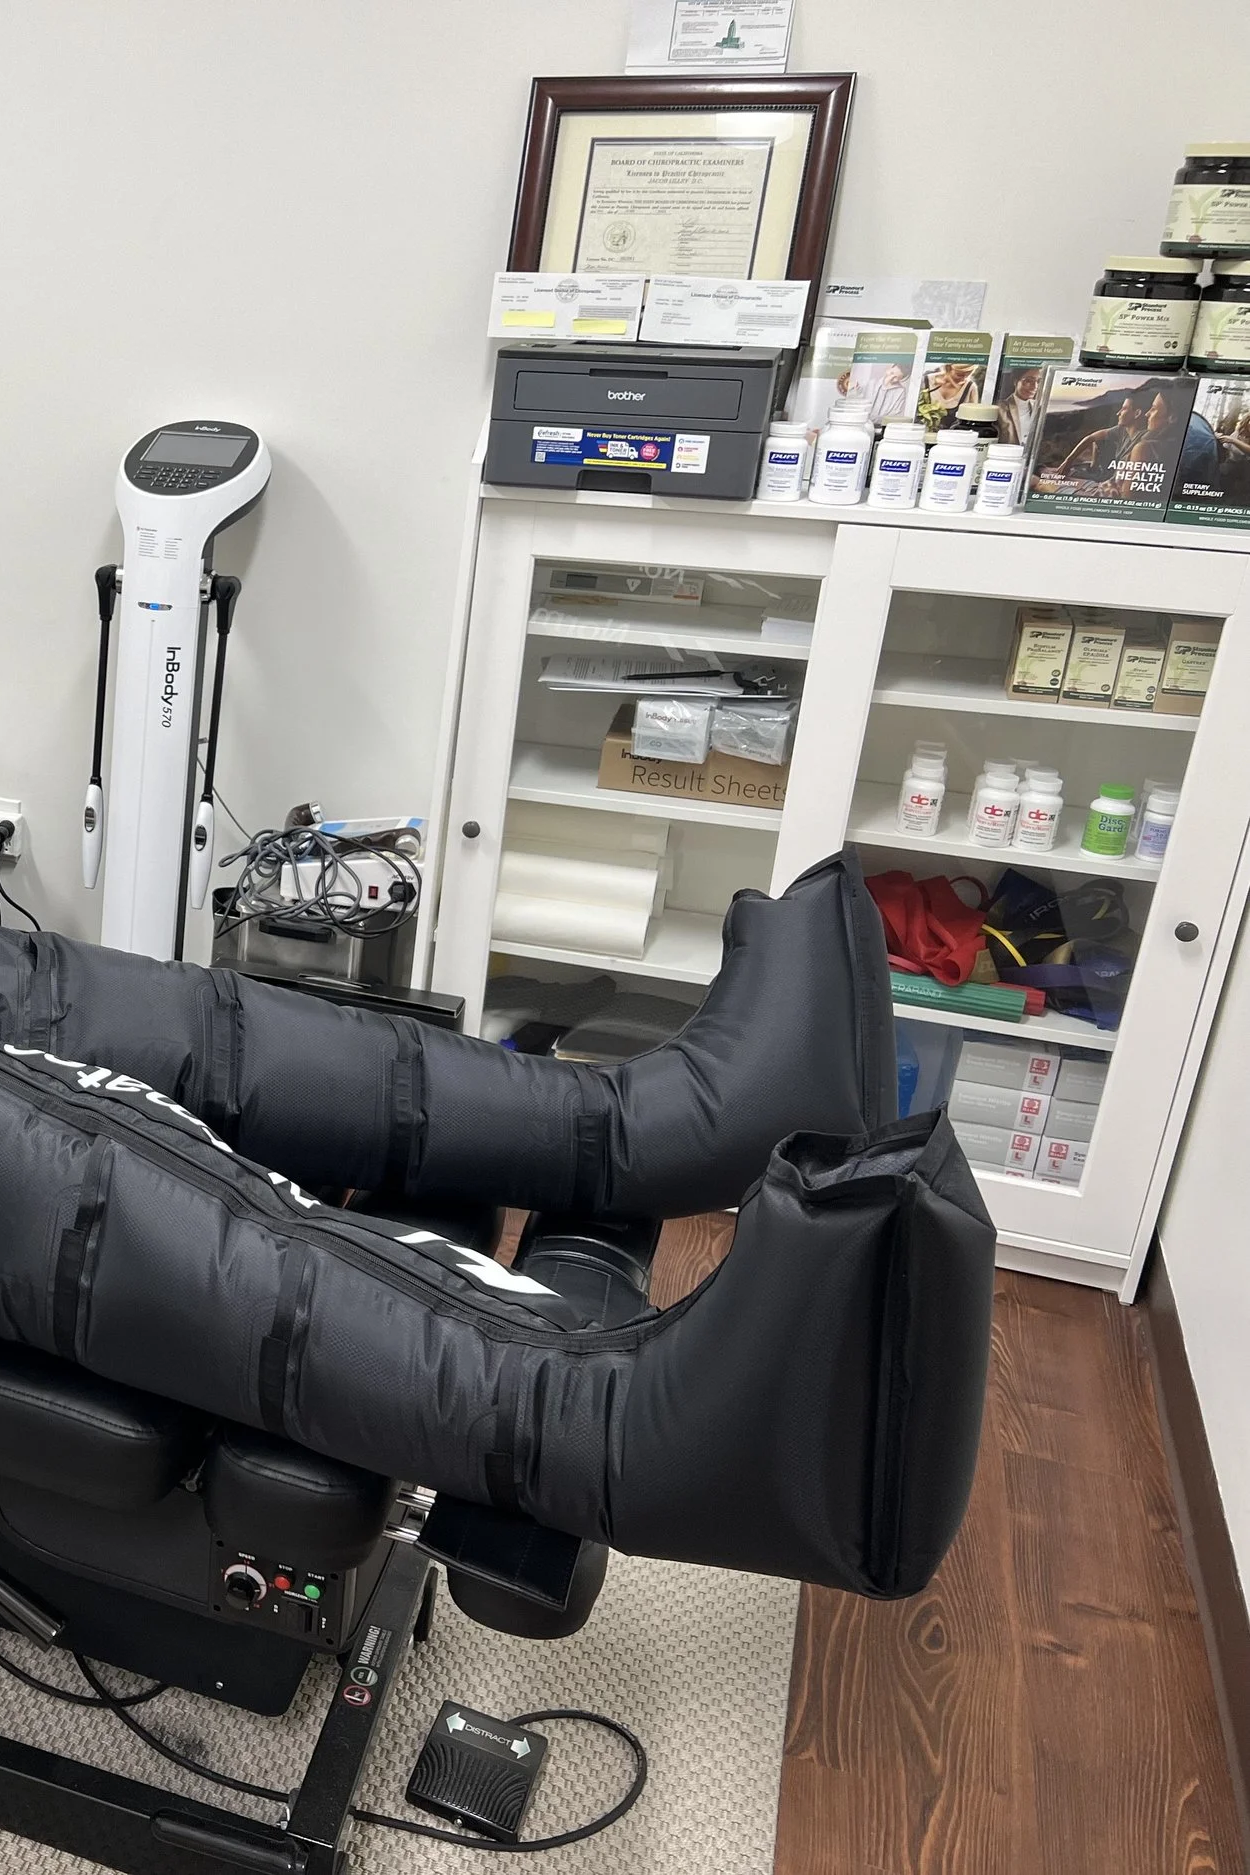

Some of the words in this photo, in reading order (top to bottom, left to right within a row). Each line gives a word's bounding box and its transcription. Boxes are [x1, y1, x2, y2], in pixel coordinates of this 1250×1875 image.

[608, 390, 646, 401] brother
[195, 425, 222, 433] InBody
[1108, 460, 1167, 473] ADRENAL
[1115, 470, 1164, 483] HEALTH
[1039, 479, 1079, 487] SUPPLEMENT
[1130, 481, 1162, 493] PACK
[1182, 489, 1225, 498] SUPPLEMENT
[161, 646, 181, 706] InBody
[161, 706, 172, 728] 570
[645, 712, 672, 723] InBody
[632, 765, 705, 792] Result
[910, 794, 930, 806] dc
[984, 805, 1003, 817] dc
[1028, 810, 1048, 821] dc
[1098, 823, 1124, 833] Gard
[1034, 1076, 1040, 1085] L
[1024, 1116, 1031, 1125] L
[1015, 1152, 1022, 1160] L
[1052, 1160, 1060, 1169] L
[238, 1552, 256, 1561] SPEED
[279, 1564, 293, 1572] STOP
[308, 1573, 325, 1581] START
[358, 1625, 382, 1665] WARNING!
[464, 1724, 512, 1746] DISTRACT
